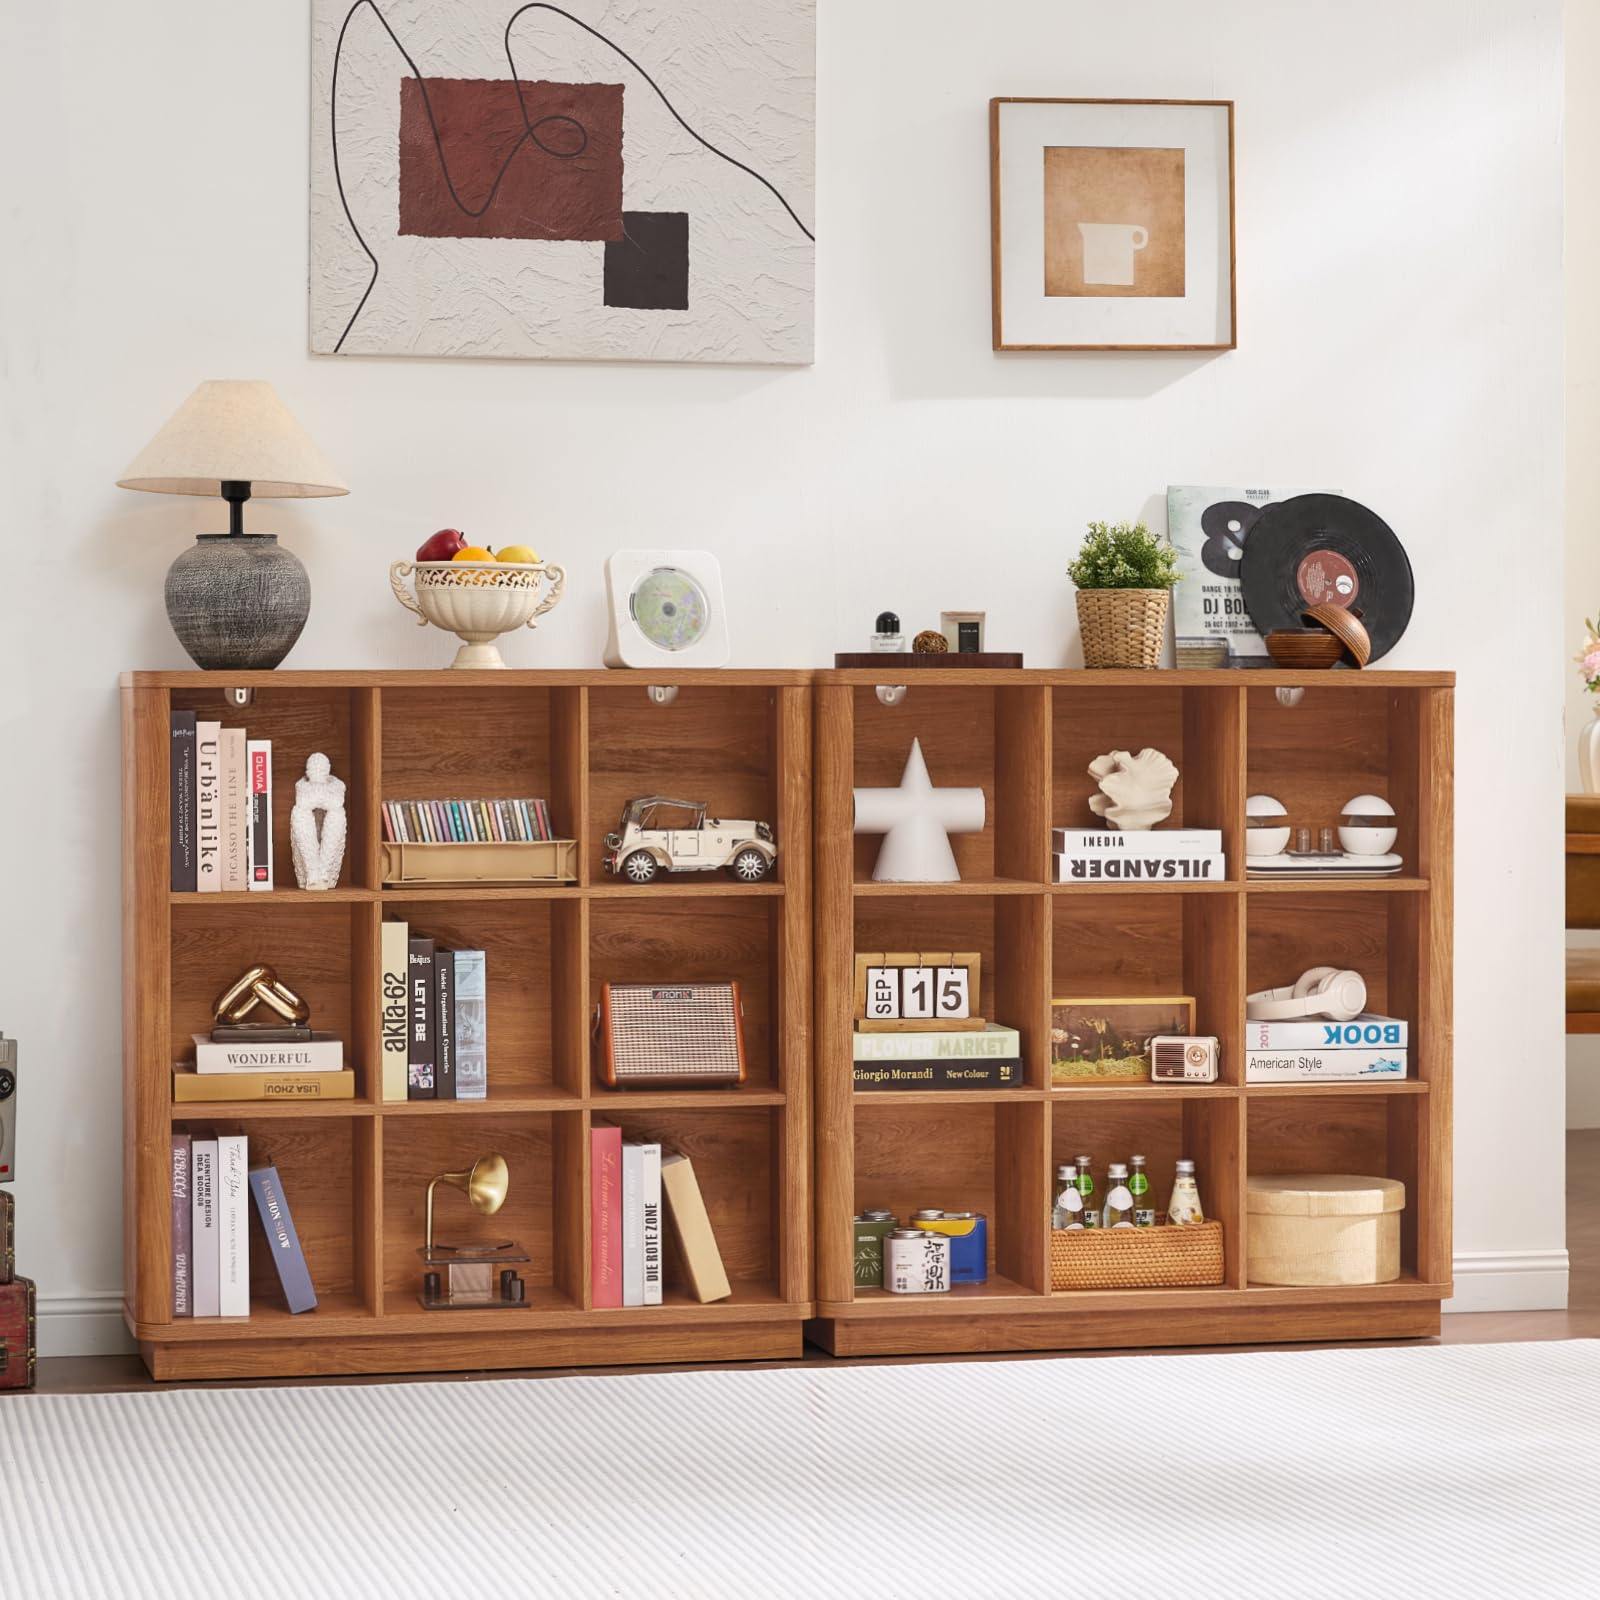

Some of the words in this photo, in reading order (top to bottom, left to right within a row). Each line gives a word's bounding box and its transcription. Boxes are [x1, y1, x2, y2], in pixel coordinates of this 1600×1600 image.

[1201, 585, 1221, 593] DANCE
[1203, 598, 1219, 615] DJ
[228, 767, 237, 799] LINE
[255, 755, 264, 791] OLIVIA
[200, 740, 218, 873] Urbänlike
[228, 804, 237, 826] THE
[1083, 836, 1125, 848] INEDIA
[229, 832, 238, 882] PICASSO
[414, 979, 426, 1005] LET
[875, 979, 892, 1014] SEP
[414, 1007, 426, 1020] IT
[415, 1023, 427, 1042] BE
[1260, 1024, 1269, 1049] 2011
[1323, 1024, 1400, 1045] BOOK
[860, 1038, 933, 1057] FLOWER
[937, 1037, 1008, 1057] MARKET
[227, 1052, 312, 1065] WONDERFUL
[1249, 1057, 1295, 1069] American
[1298, 1056, 1322, 1072] Style
[853, 1068, 890, 1082] Giorgio
[891, 1068, 933, 1080] Morandi
[946, 1070, 963, 1079] New
[963, 1070, 989, 1079] Colour
[267, 1084, 295, 1094] ZHOU
[296, 1085, 318, 1093] LISA
[172, 1147, 187, 1198] REBECCA
[261, 1179, 282, 1221] FASHION
[273, 1219, 291, 1249] SHOW
[644, 1203, 657, 1231] ZONE
[645, 1235, 658, 1262] ROTE
[646, 1263, 659, 1282] DIE
